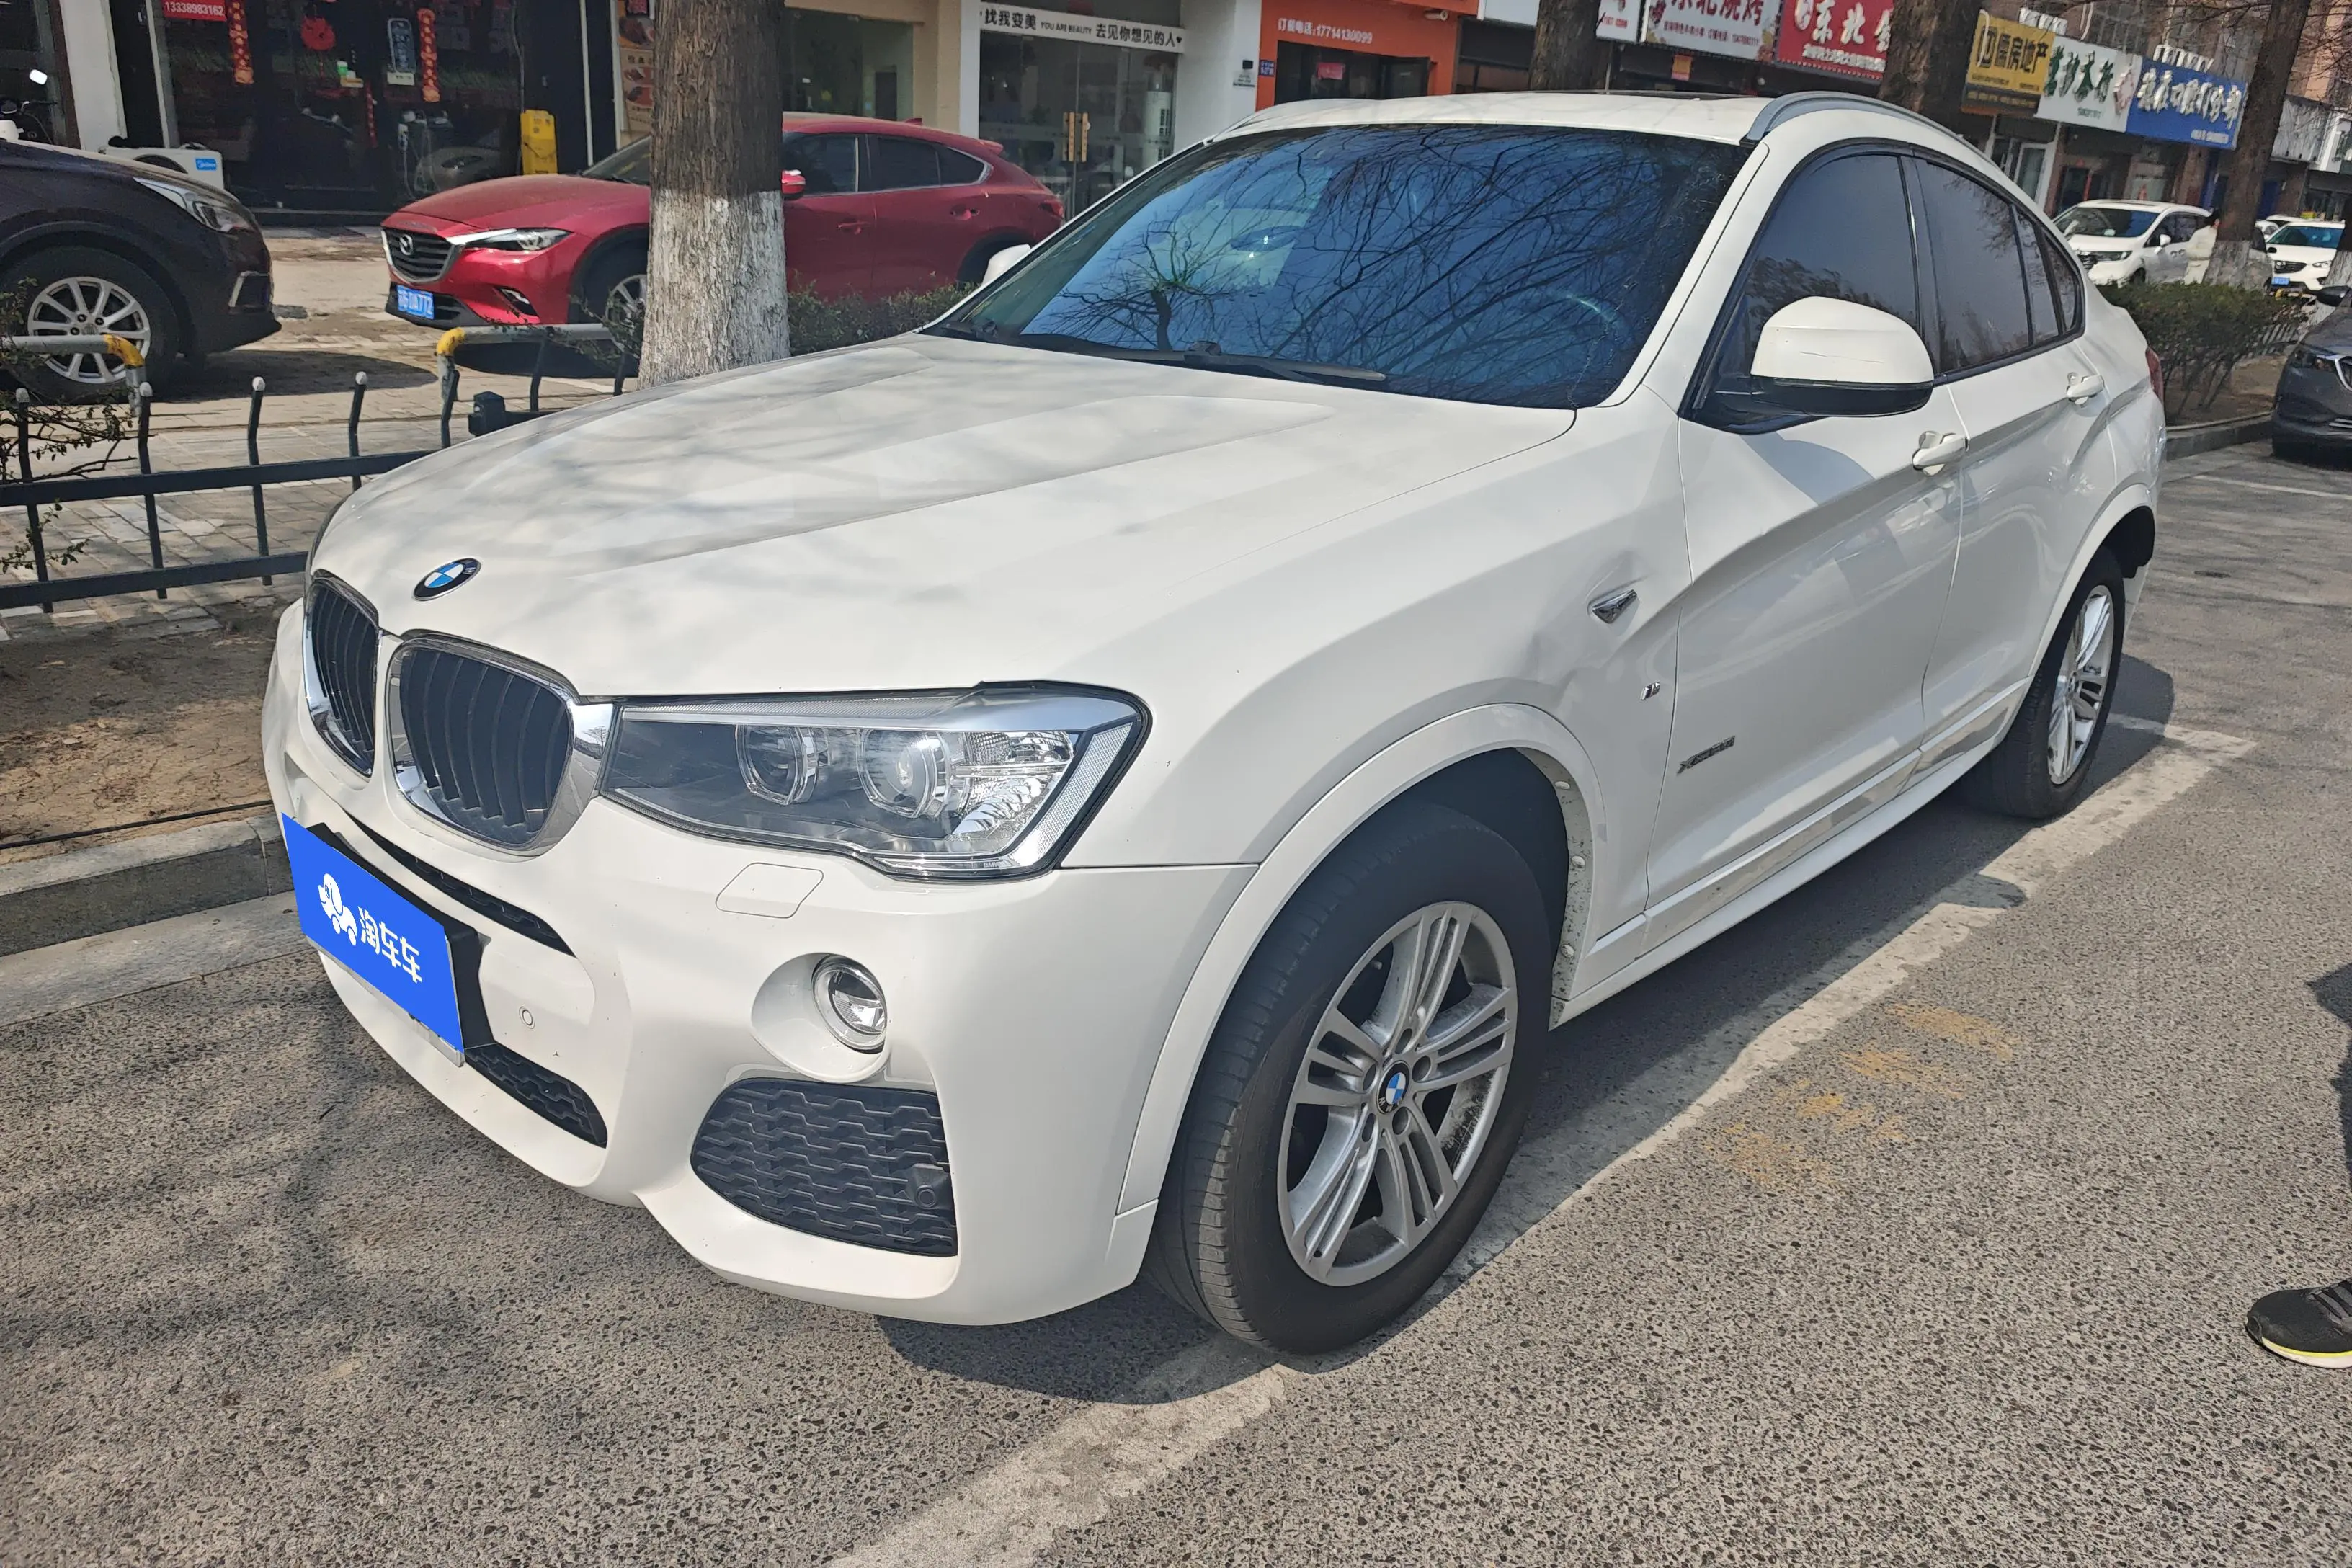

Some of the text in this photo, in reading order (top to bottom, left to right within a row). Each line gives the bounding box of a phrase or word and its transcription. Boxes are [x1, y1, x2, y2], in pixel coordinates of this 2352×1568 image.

[984, 8, 1036, 30] 找我变美
[1096, 24, 1175, 48] 去见你想见的人
